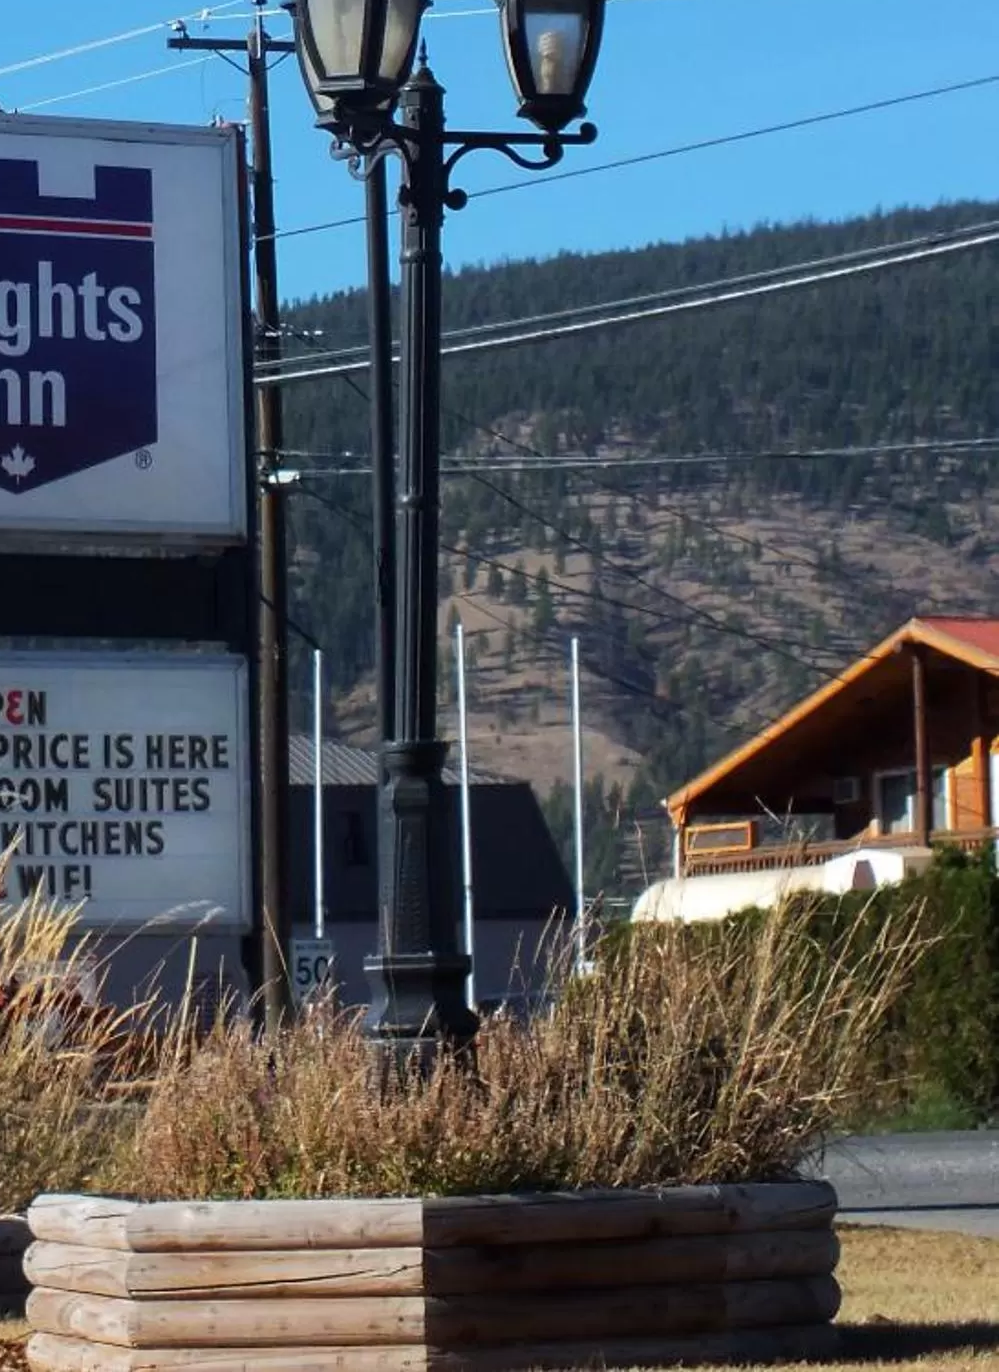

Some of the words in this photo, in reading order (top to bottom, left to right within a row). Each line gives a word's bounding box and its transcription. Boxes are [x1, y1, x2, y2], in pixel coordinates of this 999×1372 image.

[104, 734, 135, 770] IS
[146, 734, 230, 770] HERE
[93, 777, 211, 813] SUITES
[1, 820, 165, 856] KITCHENS
[296, 955, 331, 987] 50
